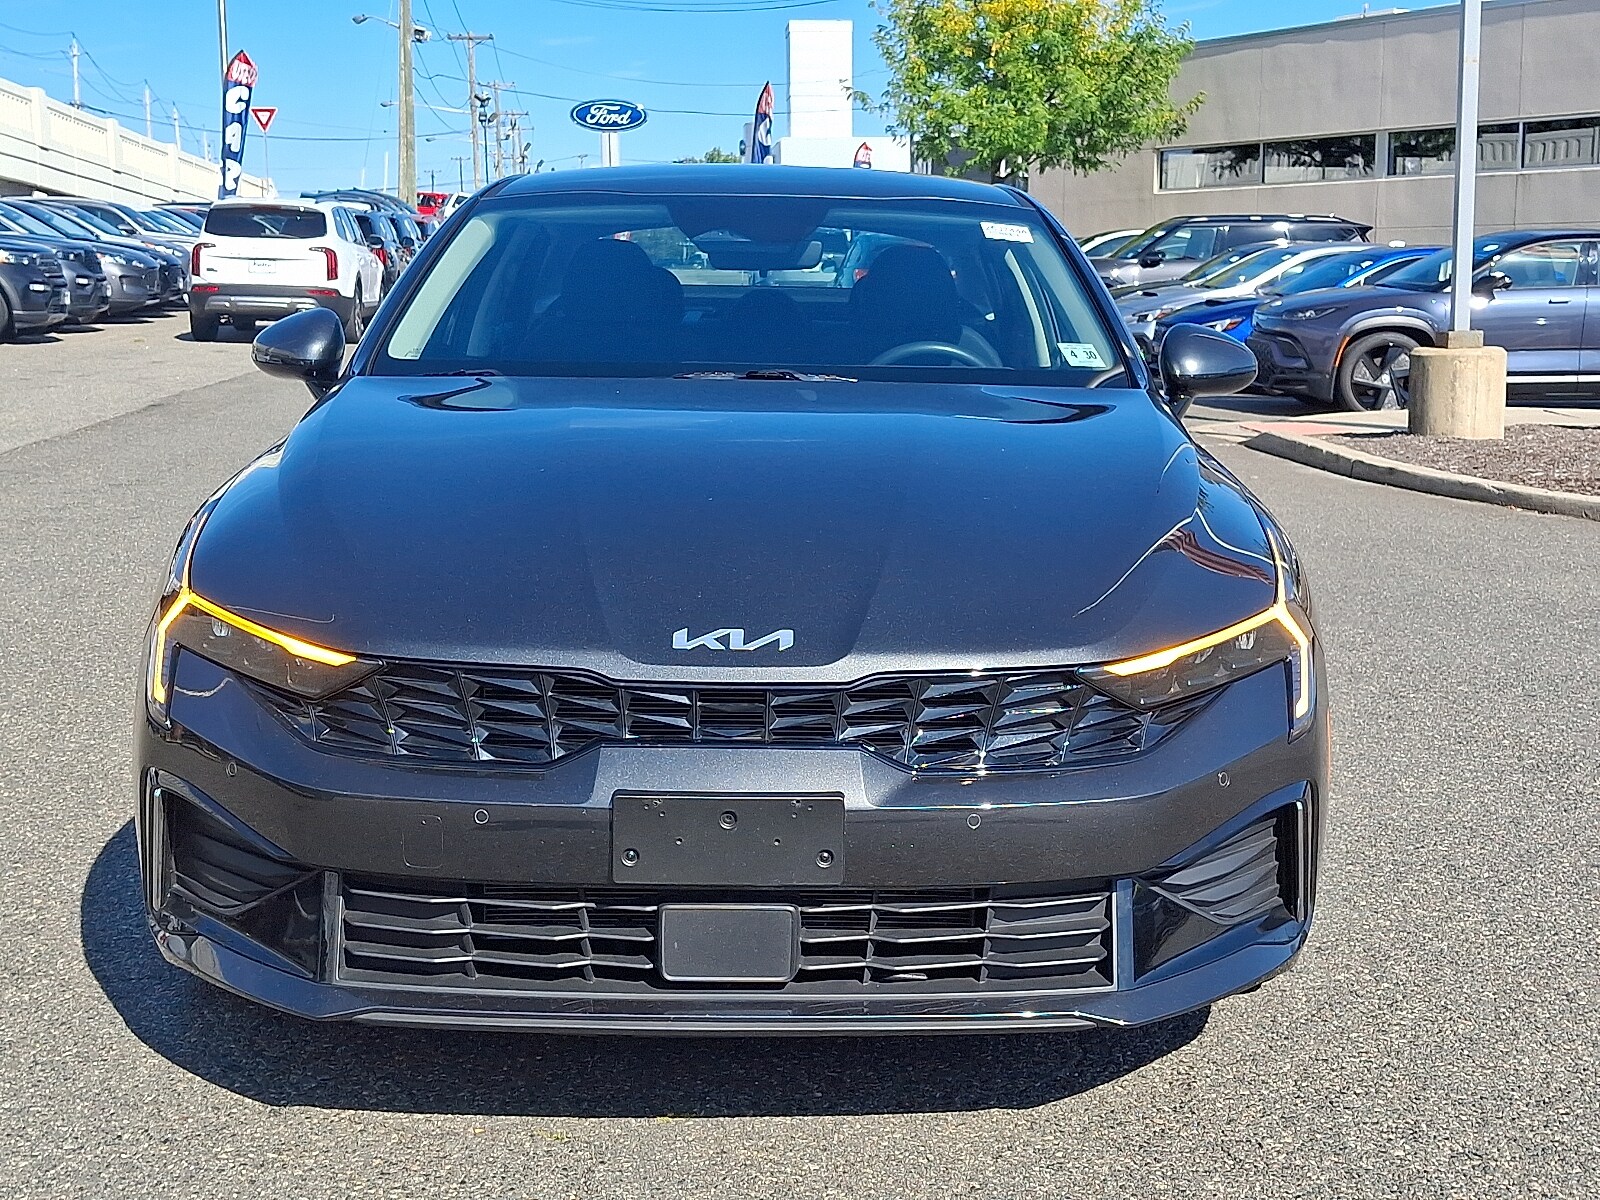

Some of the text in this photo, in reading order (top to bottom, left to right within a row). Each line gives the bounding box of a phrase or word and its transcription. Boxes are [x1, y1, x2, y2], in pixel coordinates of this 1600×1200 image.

[586, 105, 632, 124] Ford
[1071, 350, 1097, 360] 4 30
[672, 627, 794, 651] KIA
